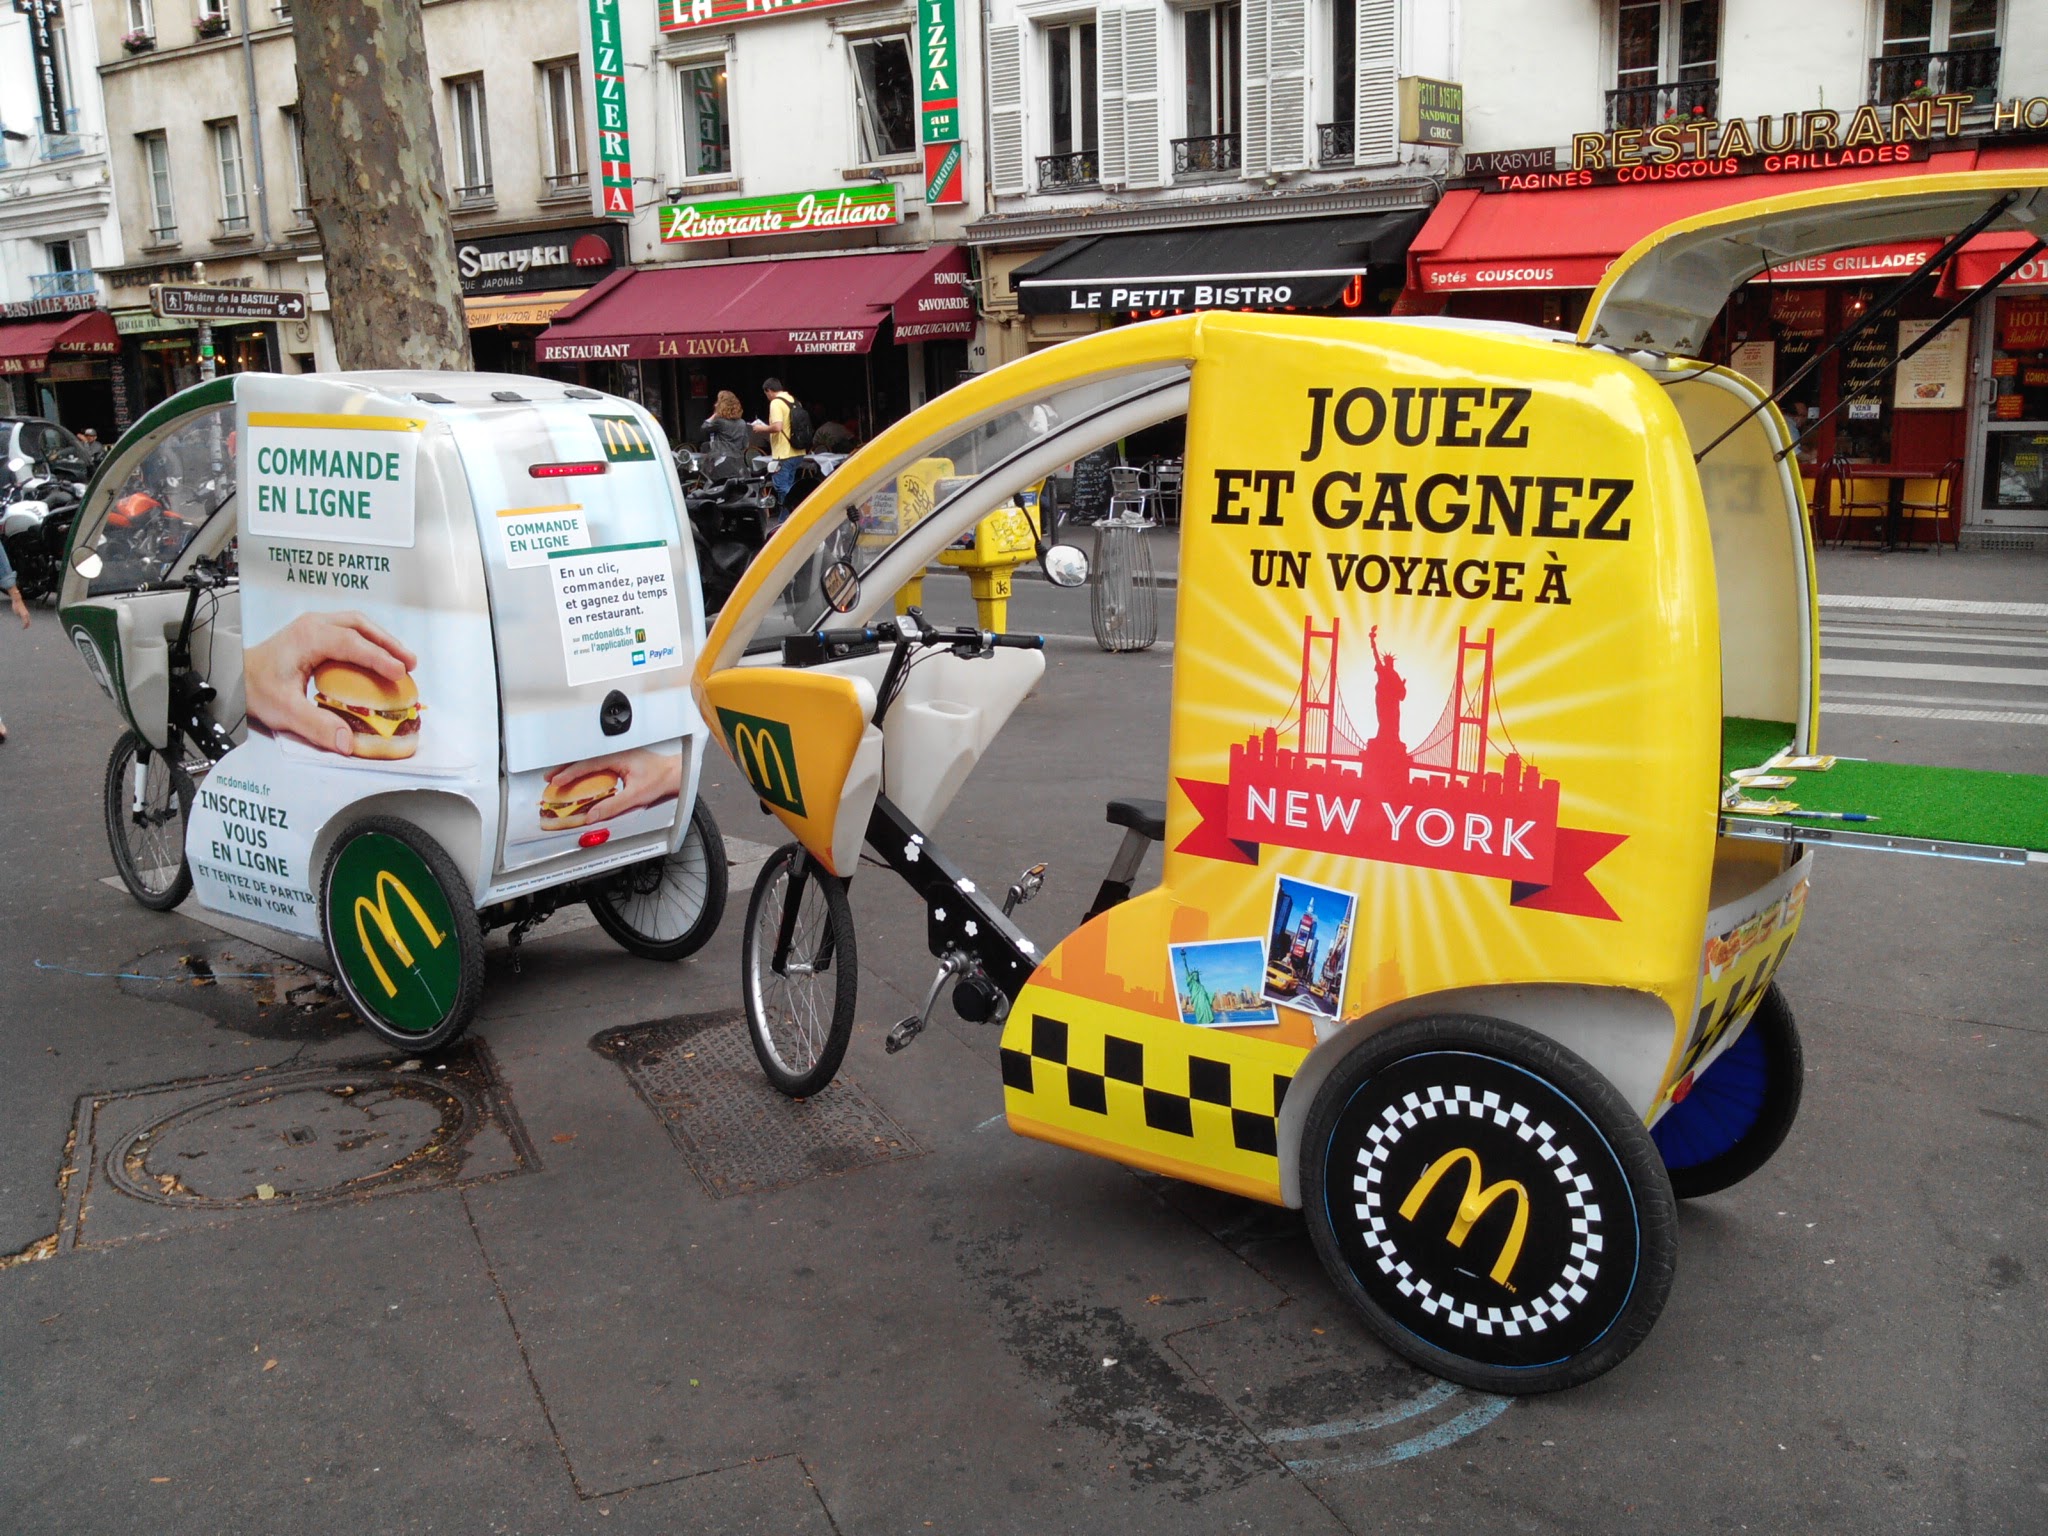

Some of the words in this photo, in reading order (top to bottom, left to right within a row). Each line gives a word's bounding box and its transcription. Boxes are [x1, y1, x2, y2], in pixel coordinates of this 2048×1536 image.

[927, 0, 949, 91] IZZA
[35, 0, 49, 47] ROYAL
[42, 55, 60, 131] BASTILLE
[596, 0, 628, 211] PIZZERIA
[1418, 82, 1436, 106] PETIT
[1440, 86, 1461, 111] BISTRO
[931, 115, 949, 125] au
[1420, 109, 1460, 125] SANDWICH
[1430, 126, 1452, 140] GREC
[1572, 95, 1974, 171] RESTAURANT
[1466, 156, 1484, 172] LA
[1490, 150, 1552, 173] KABYLIE
[1497, 171, 1592, 190] TAGINES
[1617, 157, 1738, 183] COUSCOUS
[1764, 144, 1910, 172] GRILLADES
[666, 206, 782, 240] Ristorante
[789, 192, 891, 230] Italiano
[1833, 252, 1927, 271] GRILLADES
[482, 276, 523, 288] JAPONAIS
[934, 273, 967, 285] FONDUE
[1431, 272, 1467, 286] Sptés
[1475, 268, 1554, 283] COUSCOUS
[5, 297, 62, 318] BASTILLE
[66, 294, 92, 312] BAR
[183, 291, 215, 303] Théâtre
[218, 293, 229, 304] de
[231, 293, 239, 304] la
[240, 294, 280, 305] BASTILLE
[918, 297, 970, 312] SAVOYARDE
[1070, 289, 1101, 309] LE
[1111, 288, 1185, 308] PETIT
[1194, 285, 1292, 306] BISTRO
[197, 304, 212, 314] Rue
[214, 305, 224, 314] de
[227, 305, 235, 314] la
[237, 305, 272, 317] Roquette
[496, 310, 531, 322] YAKITORI
[788, 331, 817, 342] PIZZA
[819, 331, 832, 341] ET
[834, 330, 864, 341] PLATS
[895, 321, 972, 338] BOURGUIGNONNE
[93, 342, 115, 351] BAR
[545, 343, 630, 360] RESTAURANT
[658, 340, 679, 356] LA
[686, 337, 750, 355] TAVOLA
[804, 342, 857, 353] EMPORTER
[973, 346, 985, 356] 10
[1300, 386, 1533, 463] JOUEZ
[257, 447, 400, 481] COMMANDE
[258, 485, 287, 514] EN
[296, 487, 371, 520] LIGNE
[1211, 469, 1295, 527] ET
[1311, 471, 1635, 542] GAGNEZ
[507, 519, 579, 537] COMMANDE
[510, 540, 527, 553] EN
[531, 535, 570, 551] LIGNE
[268, 547, 313, 566] TENTEZ
[317, 551, 334, 567] DE
[339, 553, 391, 573] PARTIR
[560, 568, 575, 579] En
[579, 566, 593, 577] un
[597, 562, 620, 575] clic,
[287, 562, 296, 582] À
[299, 568, 327, 586] NEW
[332, 572, 369, 590] YORK
[563, 577, 634, 595] commandez,
[637, 573, 666, 587] payez
[1250, 549, 1311, 590] UN
[1327, 553, 1526, 603] VOYAGE
[1534, 551, 1572, 606] À
[565, 599, 578, 610] et
[580, 595, 620, 610] gagnez
[622, 591, 635, 602] du
[637, 588, 668, 601] temps
[568, 615, 583, 625] en
[586, 605, 644, 622] restaurant.
[581, 625, 632, 642] mcdonalds.fr
[591, 637, 634, 653] l'application
[649, 647, 675, 660] PayPal
[216, 774, 271, 797] mcdonalds.fr
[201, 790, 289, 830] INSCRIVEZ
[1246, 784, 1362, 836] NEW
[1381, 801, 1537, 861] YORK
[223, 820, 268, 850] VOUS
[212, 840, 232, 863] EN
[237, 847, 289, 878] LIGNE
[198, 864, 210, 878] ET
[211, 869, 250, 890] TENTEZ
[252, 880, 268, 894] DE
[271, 884, 316, 905] PARTIR
[228, 884, 236, 901] À
[238, 891, 262, 908] NEW
[264, 898, 298, 917] YORK
